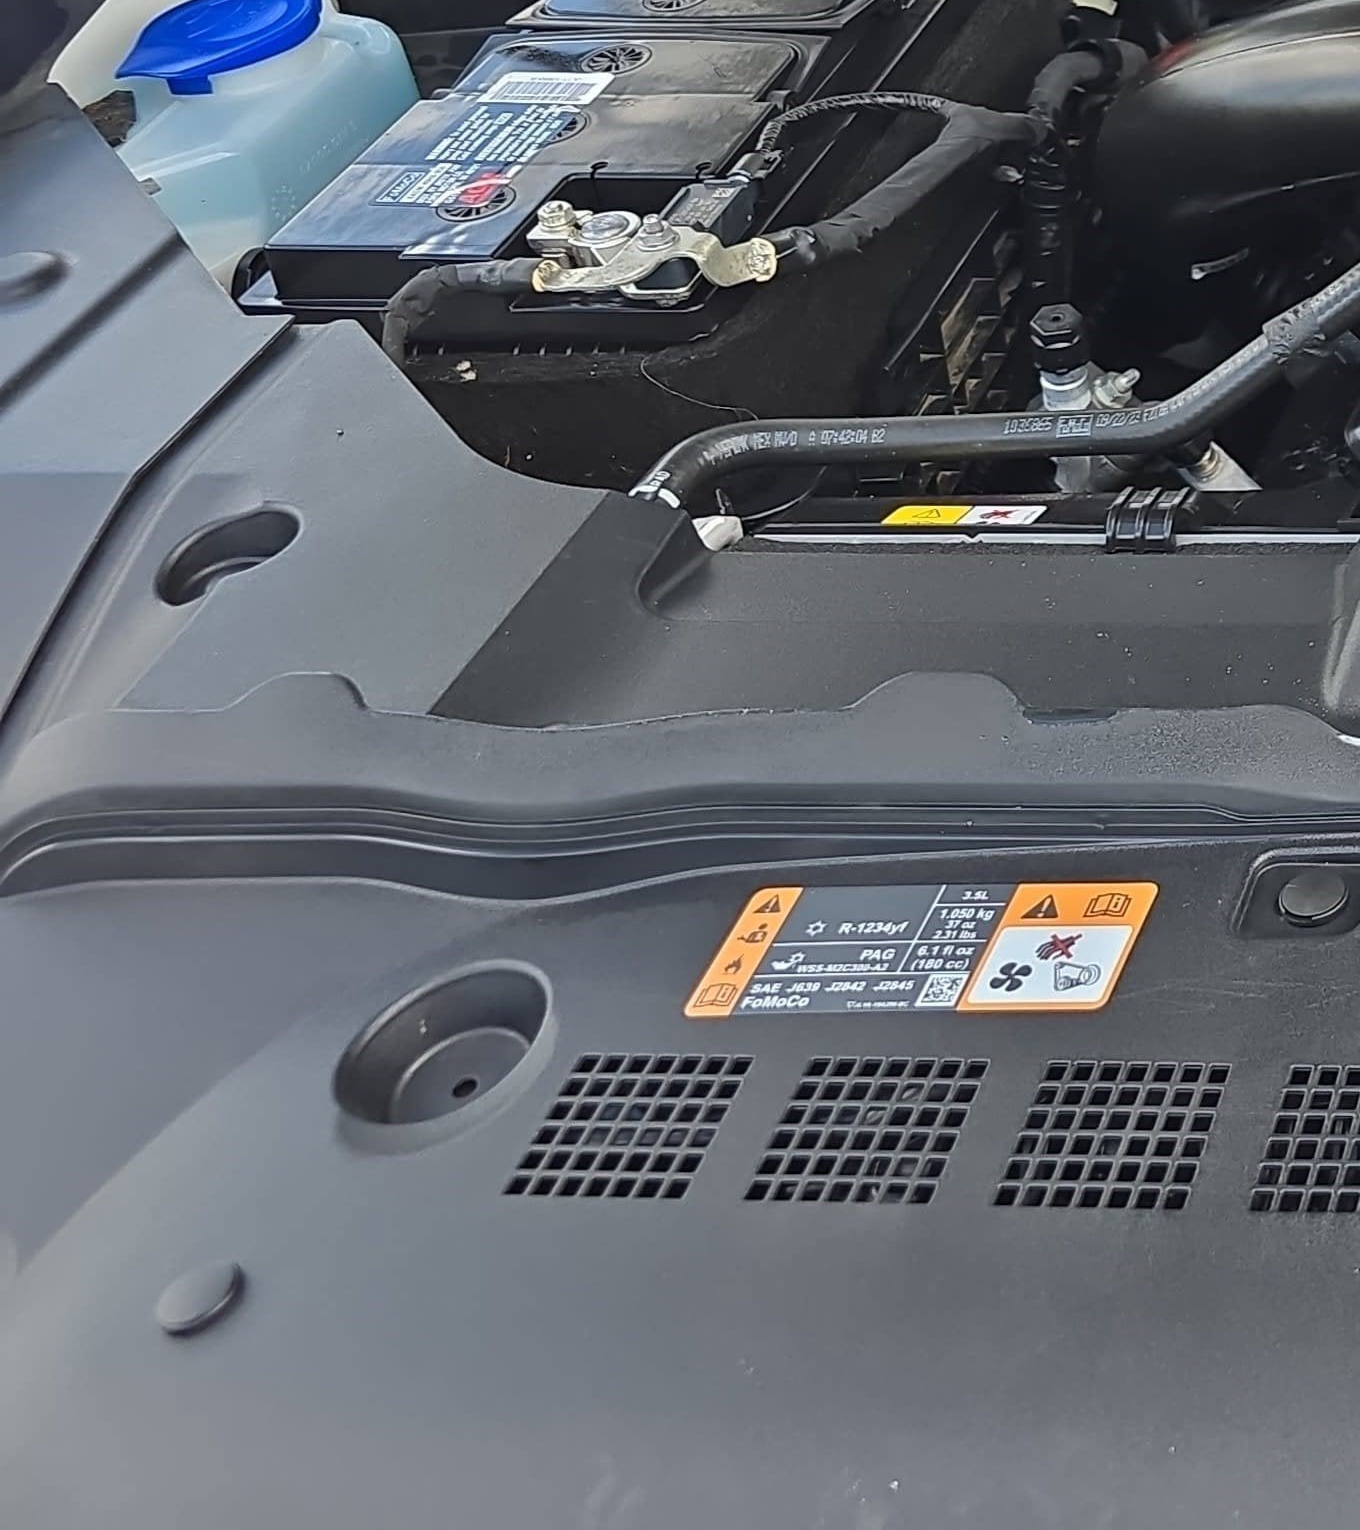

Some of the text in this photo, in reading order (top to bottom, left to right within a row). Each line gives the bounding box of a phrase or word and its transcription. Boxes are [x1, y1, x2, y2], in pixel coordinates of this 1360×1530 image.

[962, 890, 989, 901] 3.5L
[940, 908, 995, 920] 1.050 kg
[944, 920, 977, 929] 37 oz
[932, 930, 977, 940] 2.31 lbs
[859, 949, 897, 961] PAG
[917, 946, 940, 956] 6.1
[955, 947, 976, 955] oz
[910, 958, 969, 971] (180 cc)
[750, 980, 916, 994] SAE J639 J2842 J2845
[741, 995, 810, 1009] FoMoCo
